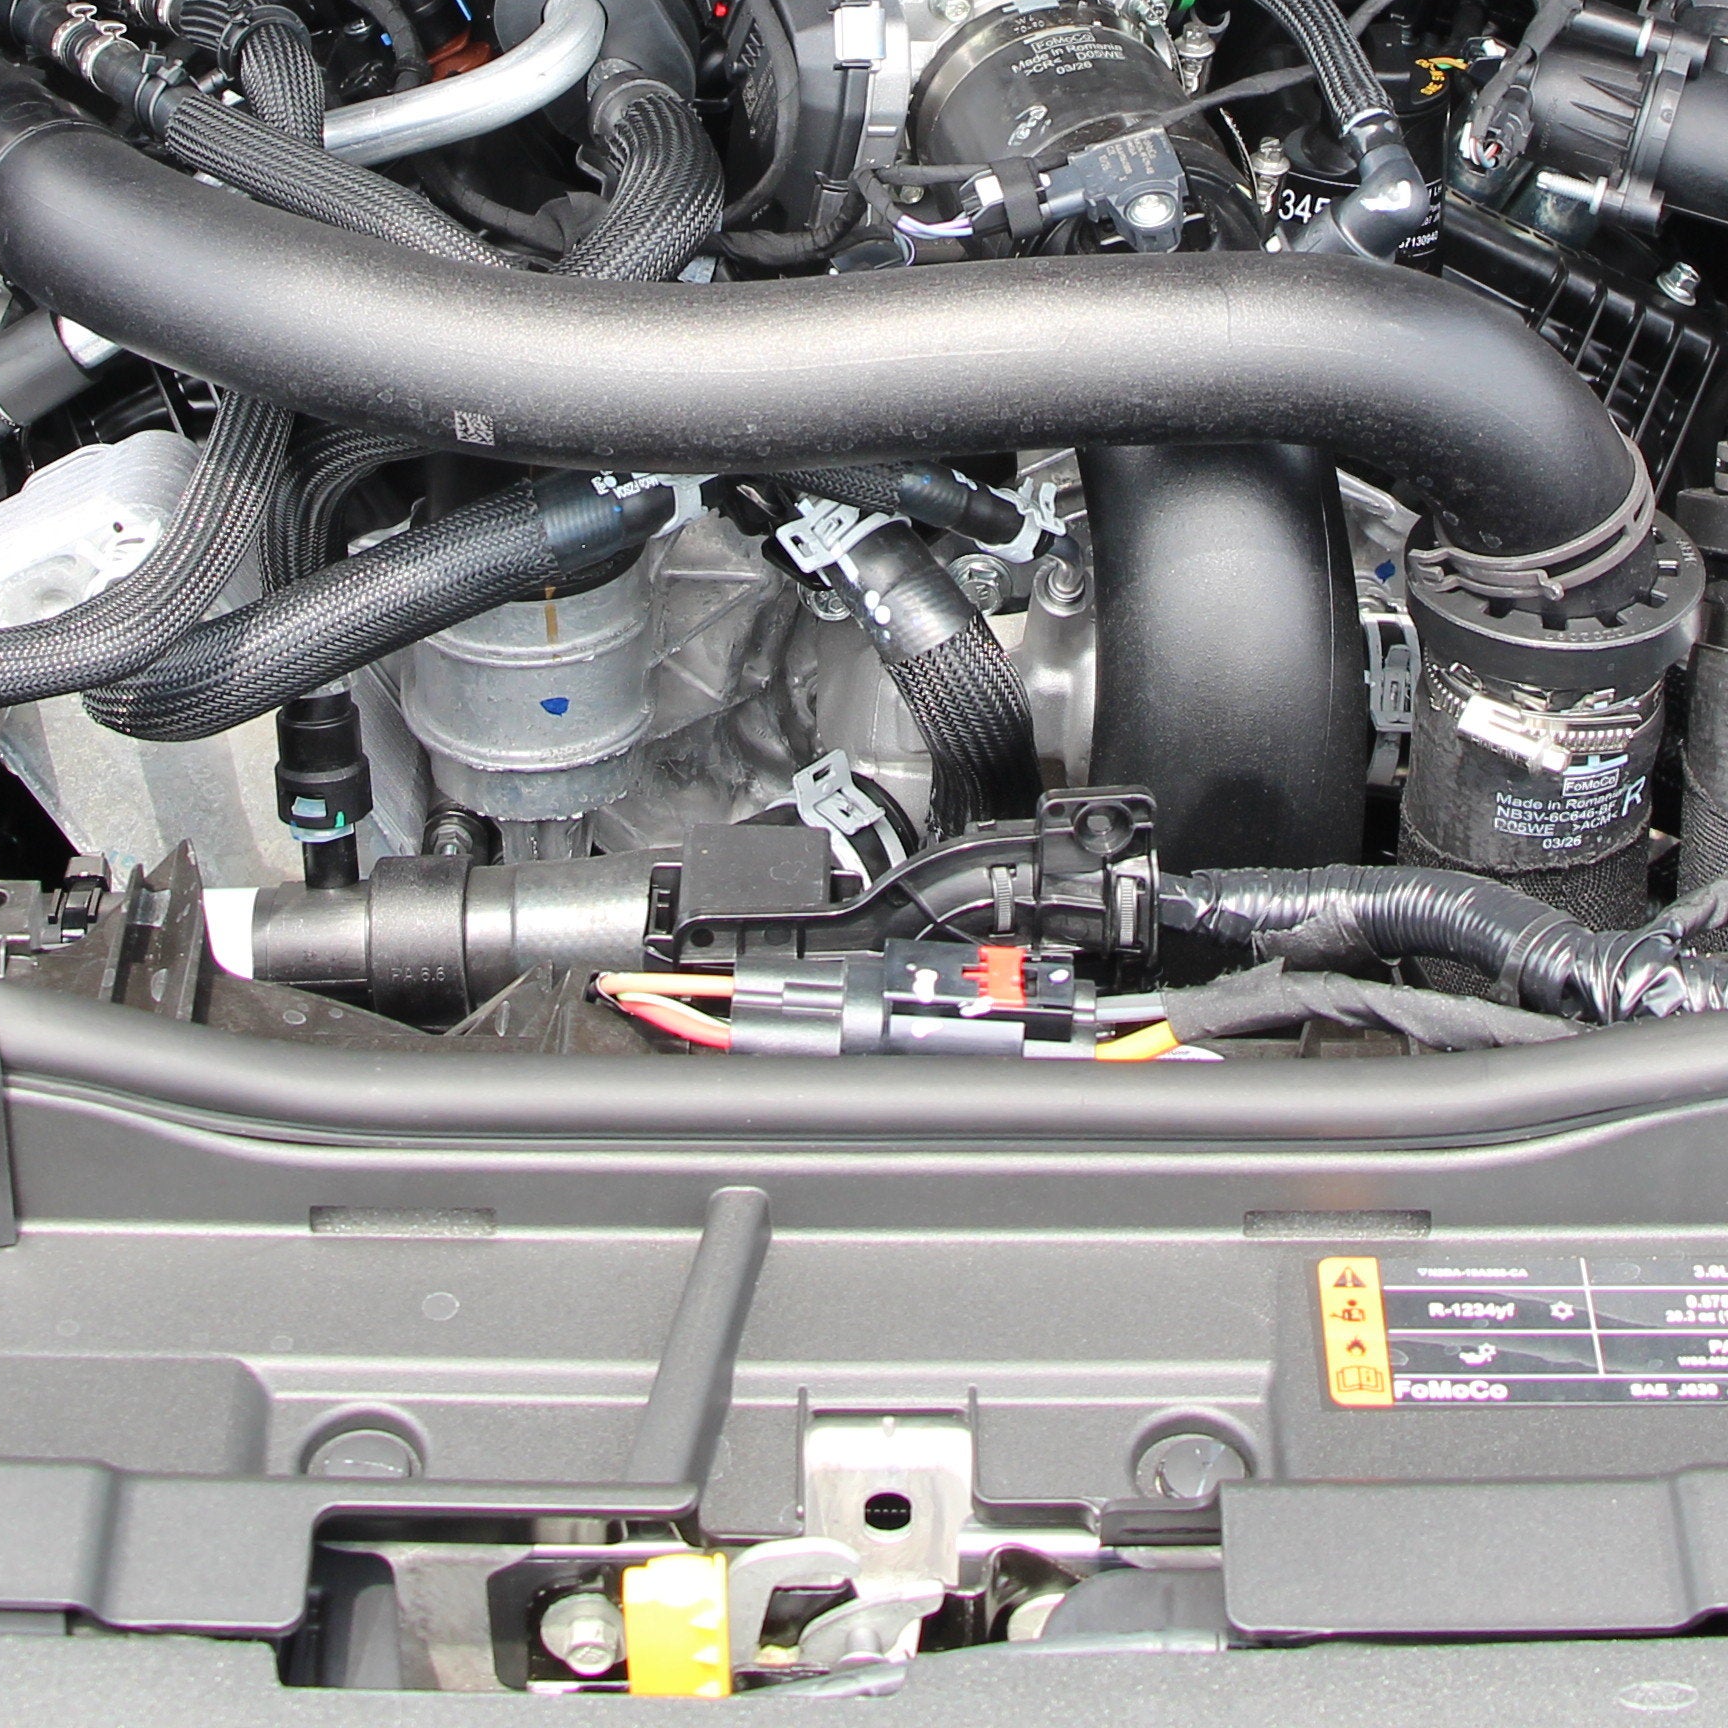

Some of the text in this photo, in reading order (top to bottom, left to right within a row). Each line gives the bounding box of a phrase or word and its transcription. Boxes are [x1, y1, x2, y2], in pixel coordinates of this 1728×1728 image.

[1011, 42, 1122, 73] Made in Romania
[1566, 774, 1616, 792] FoMoCo
[1495, 792, 1543, 810] Made
[1547, 799, 1561, 810] in
[1622, 775, 1646, 817] R
[1542, 834, 1582, 850] 03/26
[1428, 1302, 1515, 1320] R-1234yf
[1393, 1379, 1508, 1400] FoMoCo
[1630, 1383, 1669, 1397] SAE
